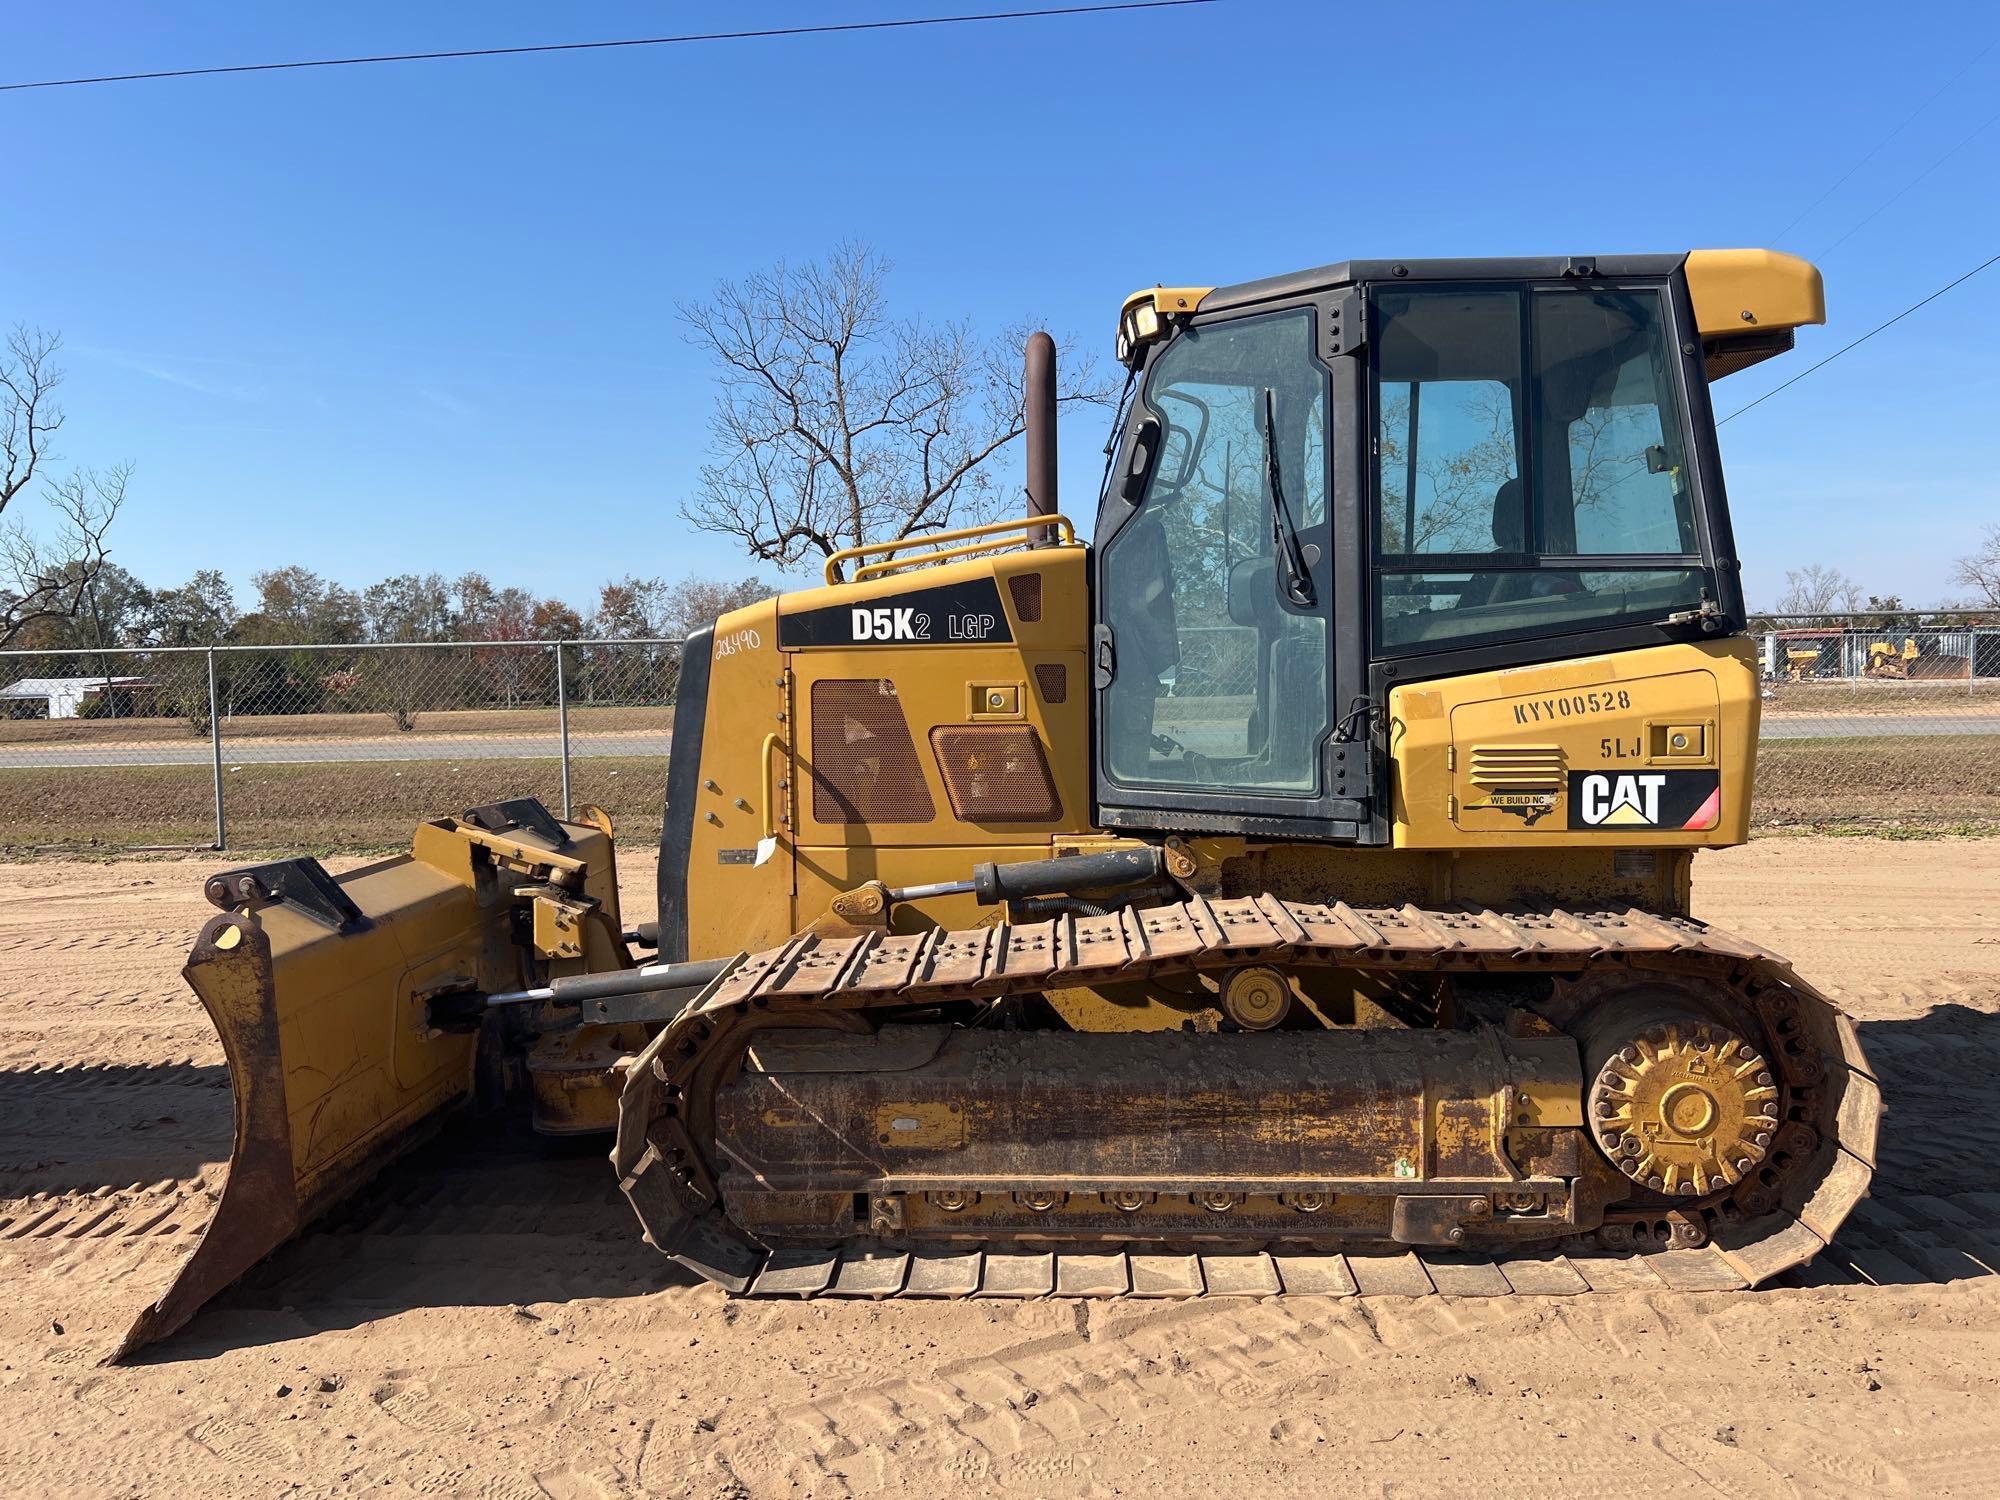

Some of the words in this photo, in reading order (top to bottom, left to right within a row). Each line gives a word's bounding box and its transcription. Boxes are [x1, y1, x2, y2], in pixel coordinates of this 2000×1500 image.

[948, 613, 995, 639] LGP
[1513, 690, 1631, 724] KYY00528
[1600, 737, 1641, 758] 5LJ
[1490, 796, 1505, 805] WE
[1506, 796, 1531, 805] BUILD
[1532, 796, 1545, 805] NC
[1581, 774, 1666, 825] CAT
